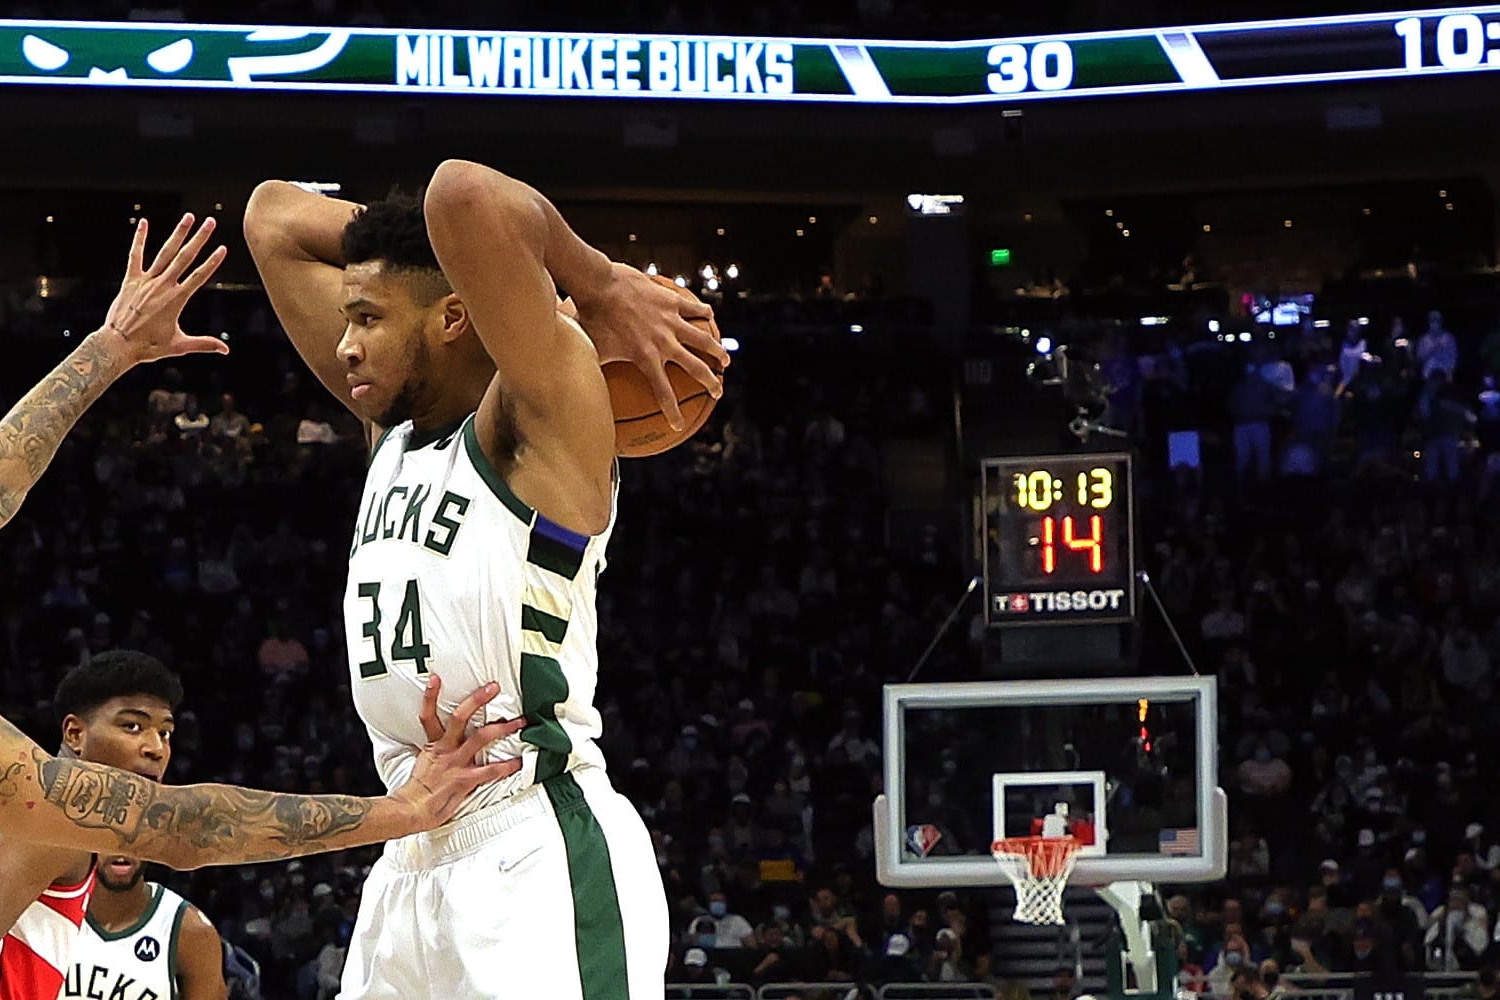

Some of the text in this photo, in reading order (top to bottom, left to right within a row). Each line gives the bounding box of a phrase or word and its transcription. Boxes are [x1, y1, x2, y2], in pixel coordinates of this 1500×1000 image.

[396, 34, 1074, 93] MILWAUKEE BUCKS 30
[1014, 468, 1112, 511] 10:13
[351, 484, 471, 558] UCKS
[1041, 514, 1103, 574] 14
[358, 578, 431, 678] 34
[1028, 589, 1124, 613] TISSOT
